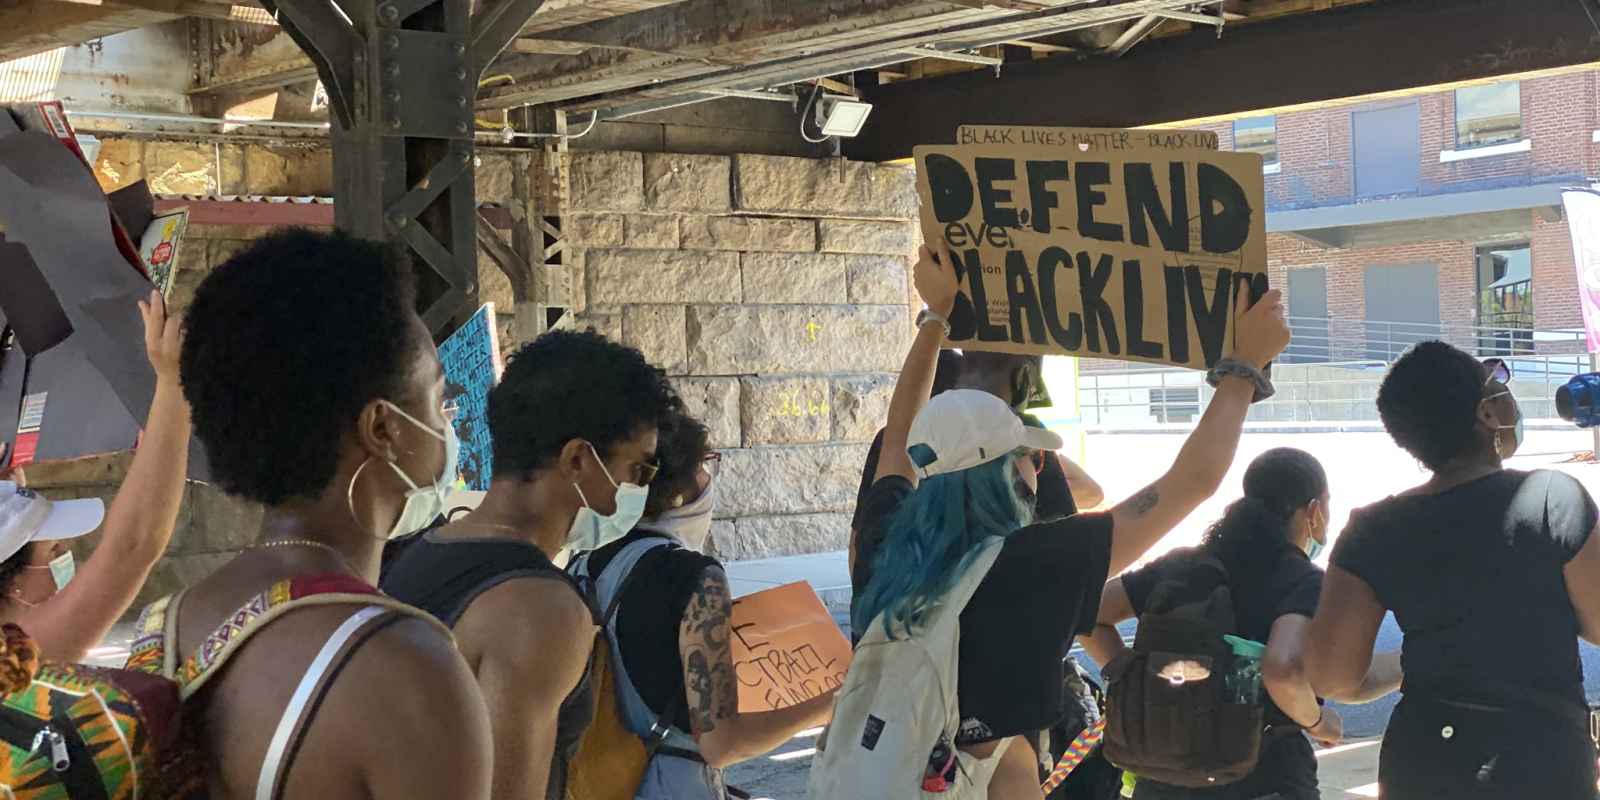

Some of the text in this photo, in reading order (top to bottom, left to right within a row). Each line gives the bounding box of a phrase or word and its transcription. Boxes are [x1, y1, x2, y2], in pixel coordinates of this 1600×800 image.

[960, 127, 1014, 145] BLACK
[1022, 128, 1066, 147] LIVES
[925, 153, 1251, 252] DEFEND
